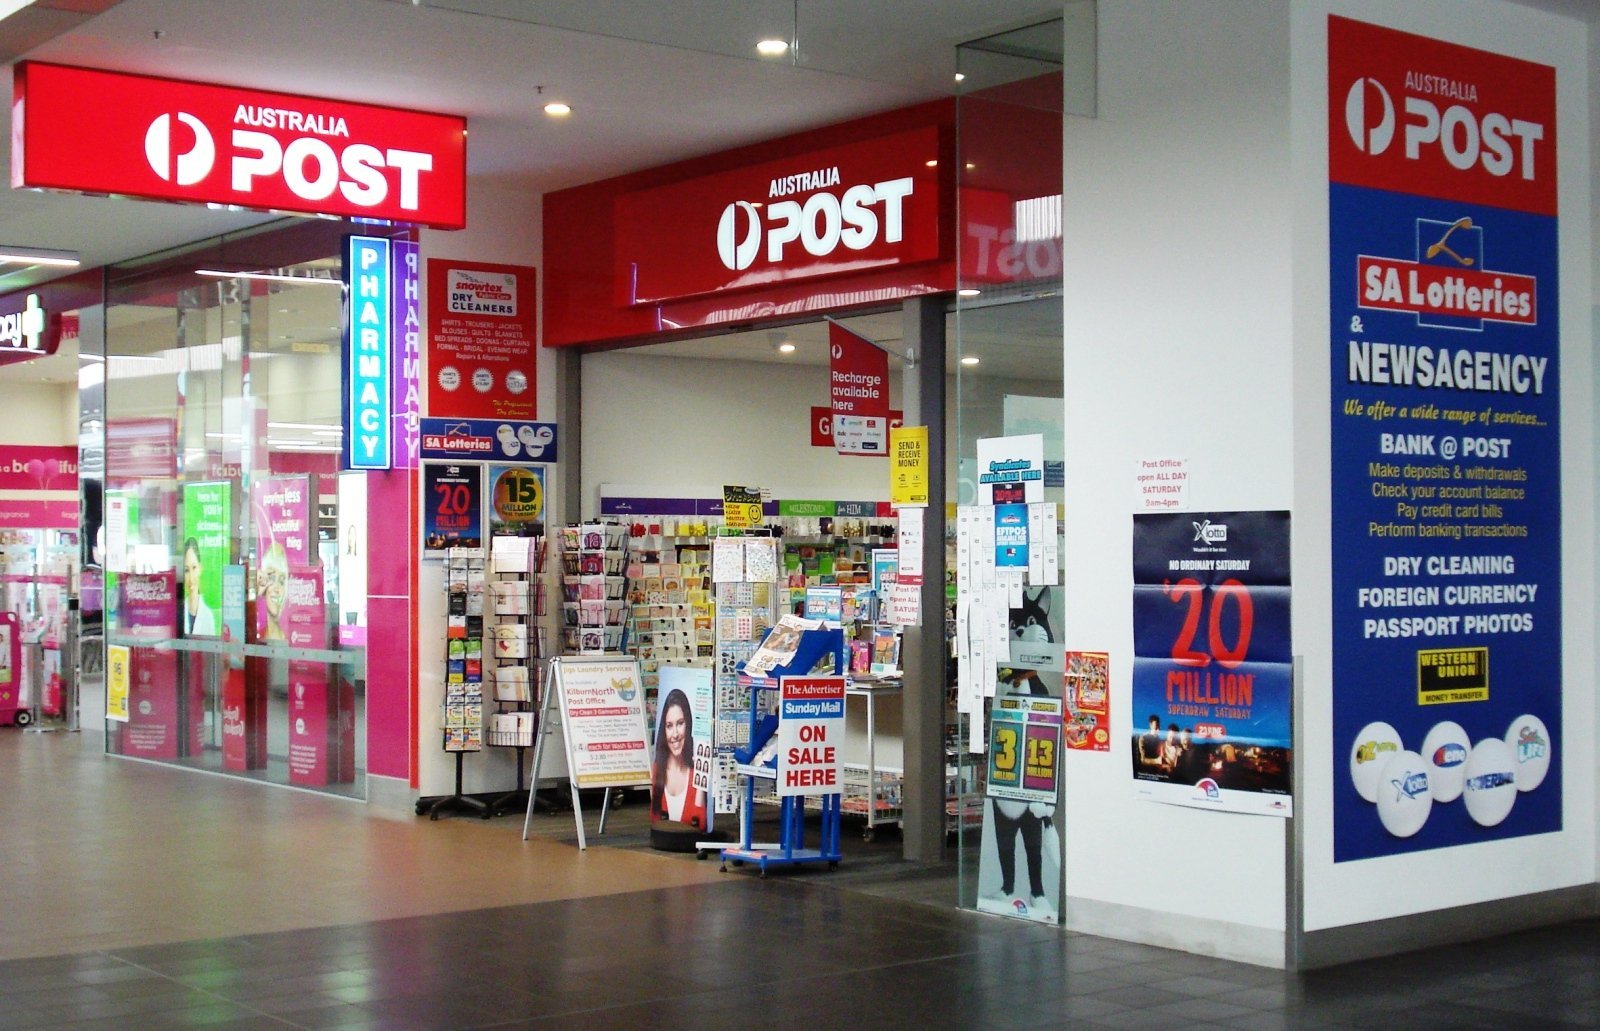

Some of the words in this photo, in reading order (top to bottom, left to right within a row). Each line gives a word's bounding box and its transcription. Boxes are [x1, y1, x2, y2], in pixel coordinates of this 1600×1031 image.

[1405, 70, 1478, 102] AUSTRALIA
[233, 104, 349, 138] AUSTRALIA
[1405, 96, 1543, 181] POST
[231, 129, 433, 210] POST
[769, 166, 840, 198] AUSTRALIA
[768, 177, 913, 262] POST
[456, 281, 503, 293] snowtex
[1365, 265, 1403, 303] SA
[1409, 270, 1530, 317] Lotteries
[452, 293, 473, 301] DRY
[452, 302, 513, 314] CLEANERS
[1350, 315, 1364, 333] &
[360, 247, 379, 458] PHARMACY
[1349, 340, 1548, 394] NEWSAGENCY
[833, 371, 881, 386] Recharge
[833, 386, 879, 398] available
[833, 399, 853, 410] here
[1344, 399, 1363, 416] We
[1367, 401, 1396, 421] offer
[1399, 407, 1407, 418] a
[1411, 403, 1439, 420] wide
[1443, 409, 1476, 426] range
[1479, 408, 1492, 427] of
[426, 437, 441, 448] SA
[443, 438, 490, 449] Lotteries
[899, 442, 914, 450] SEND
[1381, 433, 1436, 456] BANK
[1440, 436, 1458, 460] @
[1462, 437, 1511, 458] POST
[898, 450, 920, 458] RECEIVE
[898, 459, 919, 467] MONEY
[990, 460, 1031, 474] Syndicates
[1159, 460, 1182, 468] Office
[980, 471, 1020, 484] AVAILABLE
[1021, 470, 1041, 481] HERE
[1137, 474, 1154, 482] open
[1172, 472, 1187, 480] DAY
[1369, 462, 1400, 478] Make
[1403, 463, 1450, 482] deposits
[1454, 466, 1462, 479] &
[1465, 465, 1527, 481] withdrawals
[285, 488, 300, 503] less
[1142, 486, 1182, 494] SATURDAY
[1372, 482, 1408, 498] Check
[1411, 487, 1435, 502] your
[1440, 486, 1482, 499] account
[1485, 485, 1525, 500] balance
[502, 504, 536, 513] MILLION
[1145, 499, 1179, 508] 9am-4pm
[1398, 503, 1417, 520] Pay
[1421, 503, 1452, 518] credit
[1455, 503, 1479, 518] card
[1482, 503, 1503, 518] bills
[272, 520, 299, 532] beautiful
[997, 527, 1026, 537] EFTPOS
[1369, 522, 1415, 538] Perform
[1419, 522, 1462, 540] banking
[1464, 522, 1528, 538] transactions
[286, 536, 302, 550] thing
[1169, 560, 1179, 570] NO
[1180, 560, 1215, 570] ORDINARY
[1216, 560, 1250, 570] SATURDAY
[1384, 556, 1424, 576] DRY
[1427, 555, 1515, 576] CLEANING
[1358, 586, 1439, 608] FOREIGN
[1444, 584, 1538, 606] CURRENCY
[1364, 616, 1459, 639] PASSPORT
[1465, 613, 1533, 635] PHOTOS
[1421, 652, 1476, 667] WESTERN
[578, 666, 603, 674] Laundry
[1438, 664, 1476, 678] UNION
[592, 687, 615, 696] North
[786, 685, 801, 695] The
[801, 684, 841, 695] Advertiser
[1166, 671, 1254, 706] MILLION
[586, 697, 606, 705] Office
[1425, 693, 1450, 703] MONEY
[1450, 690, 1484, 701] TRANSFER
[785, 703, 820, 716] Sunday
[822, 702, 840, 713] Mail
[1168, 703, 1209, 718] SUPERDRAW
[1215, 707, 1251, 719] SATURDAY
[800, 725, 826, 742] ON
[788, 747, 835, 765] SALE
[786, 769, 836, 787] HERE
